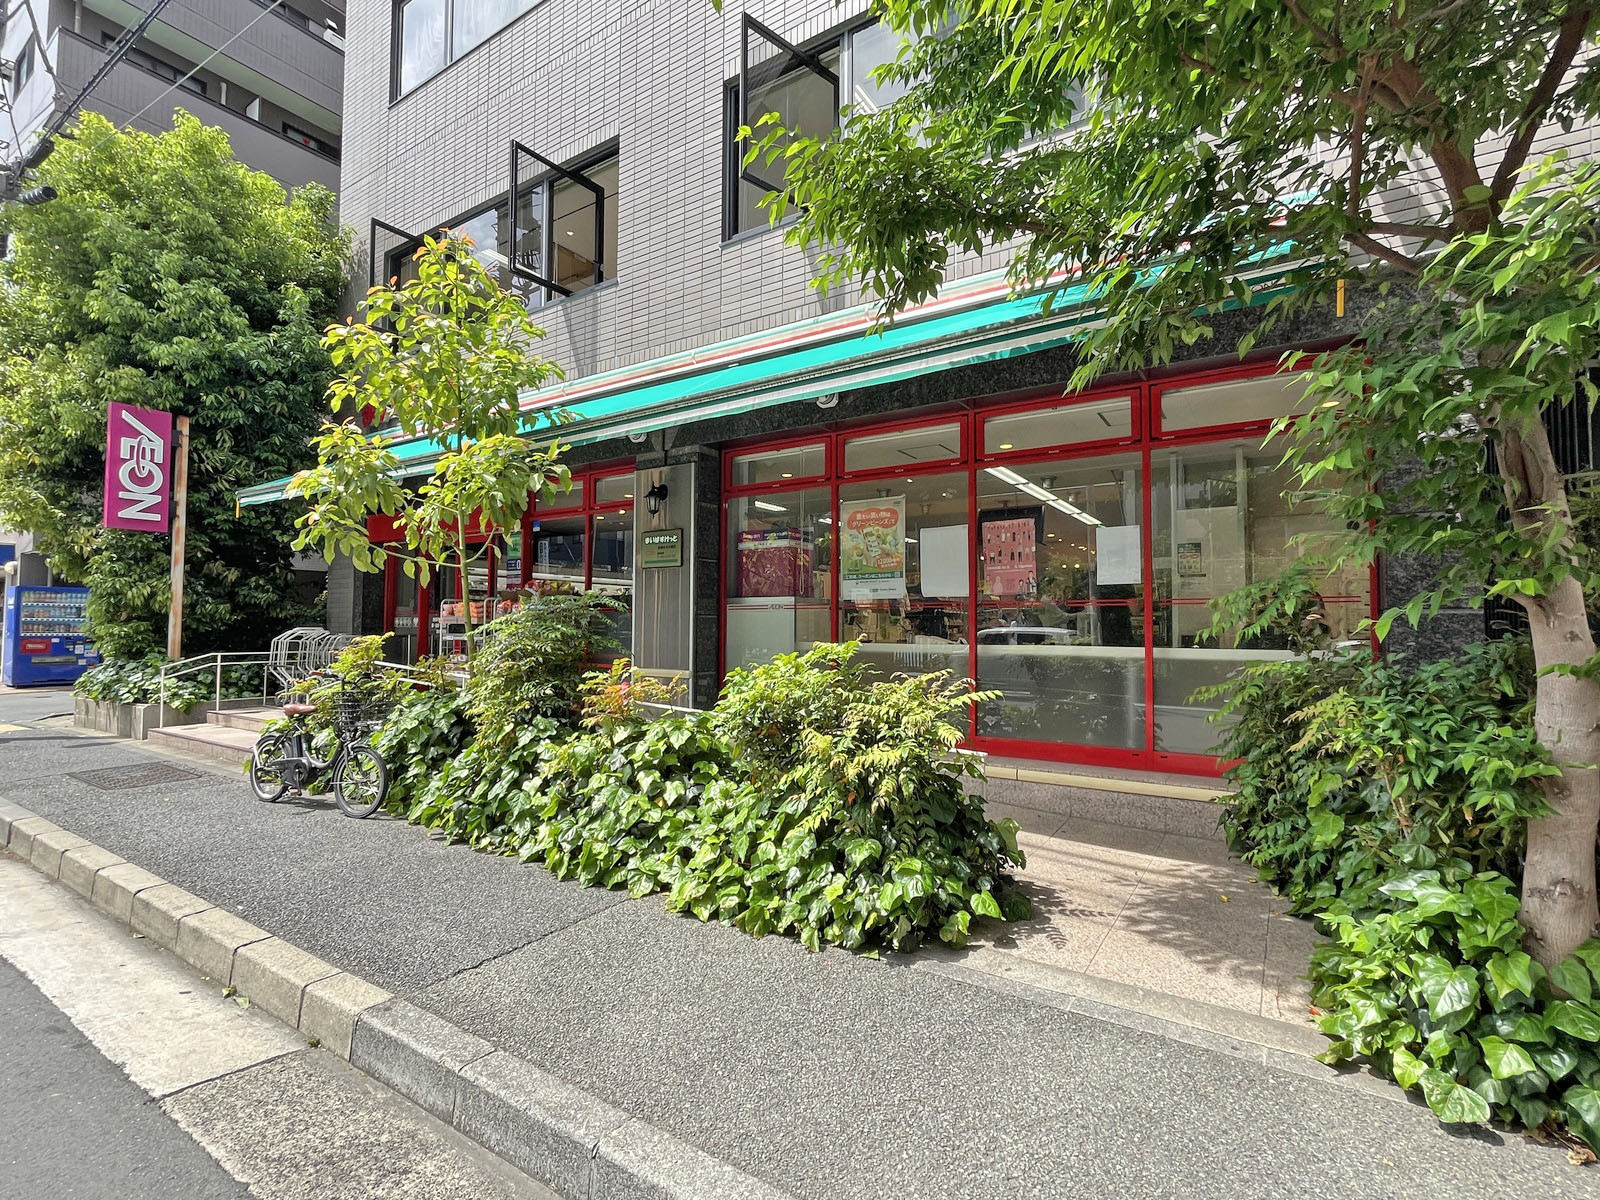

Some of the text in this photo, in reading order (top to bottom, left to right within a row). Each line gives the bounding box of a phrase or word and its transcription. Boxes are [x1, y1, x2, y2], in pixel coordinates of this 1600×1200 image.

[118, 409, 164, 521] AEON
[644, 535, 678, 545] まいばすけっと
